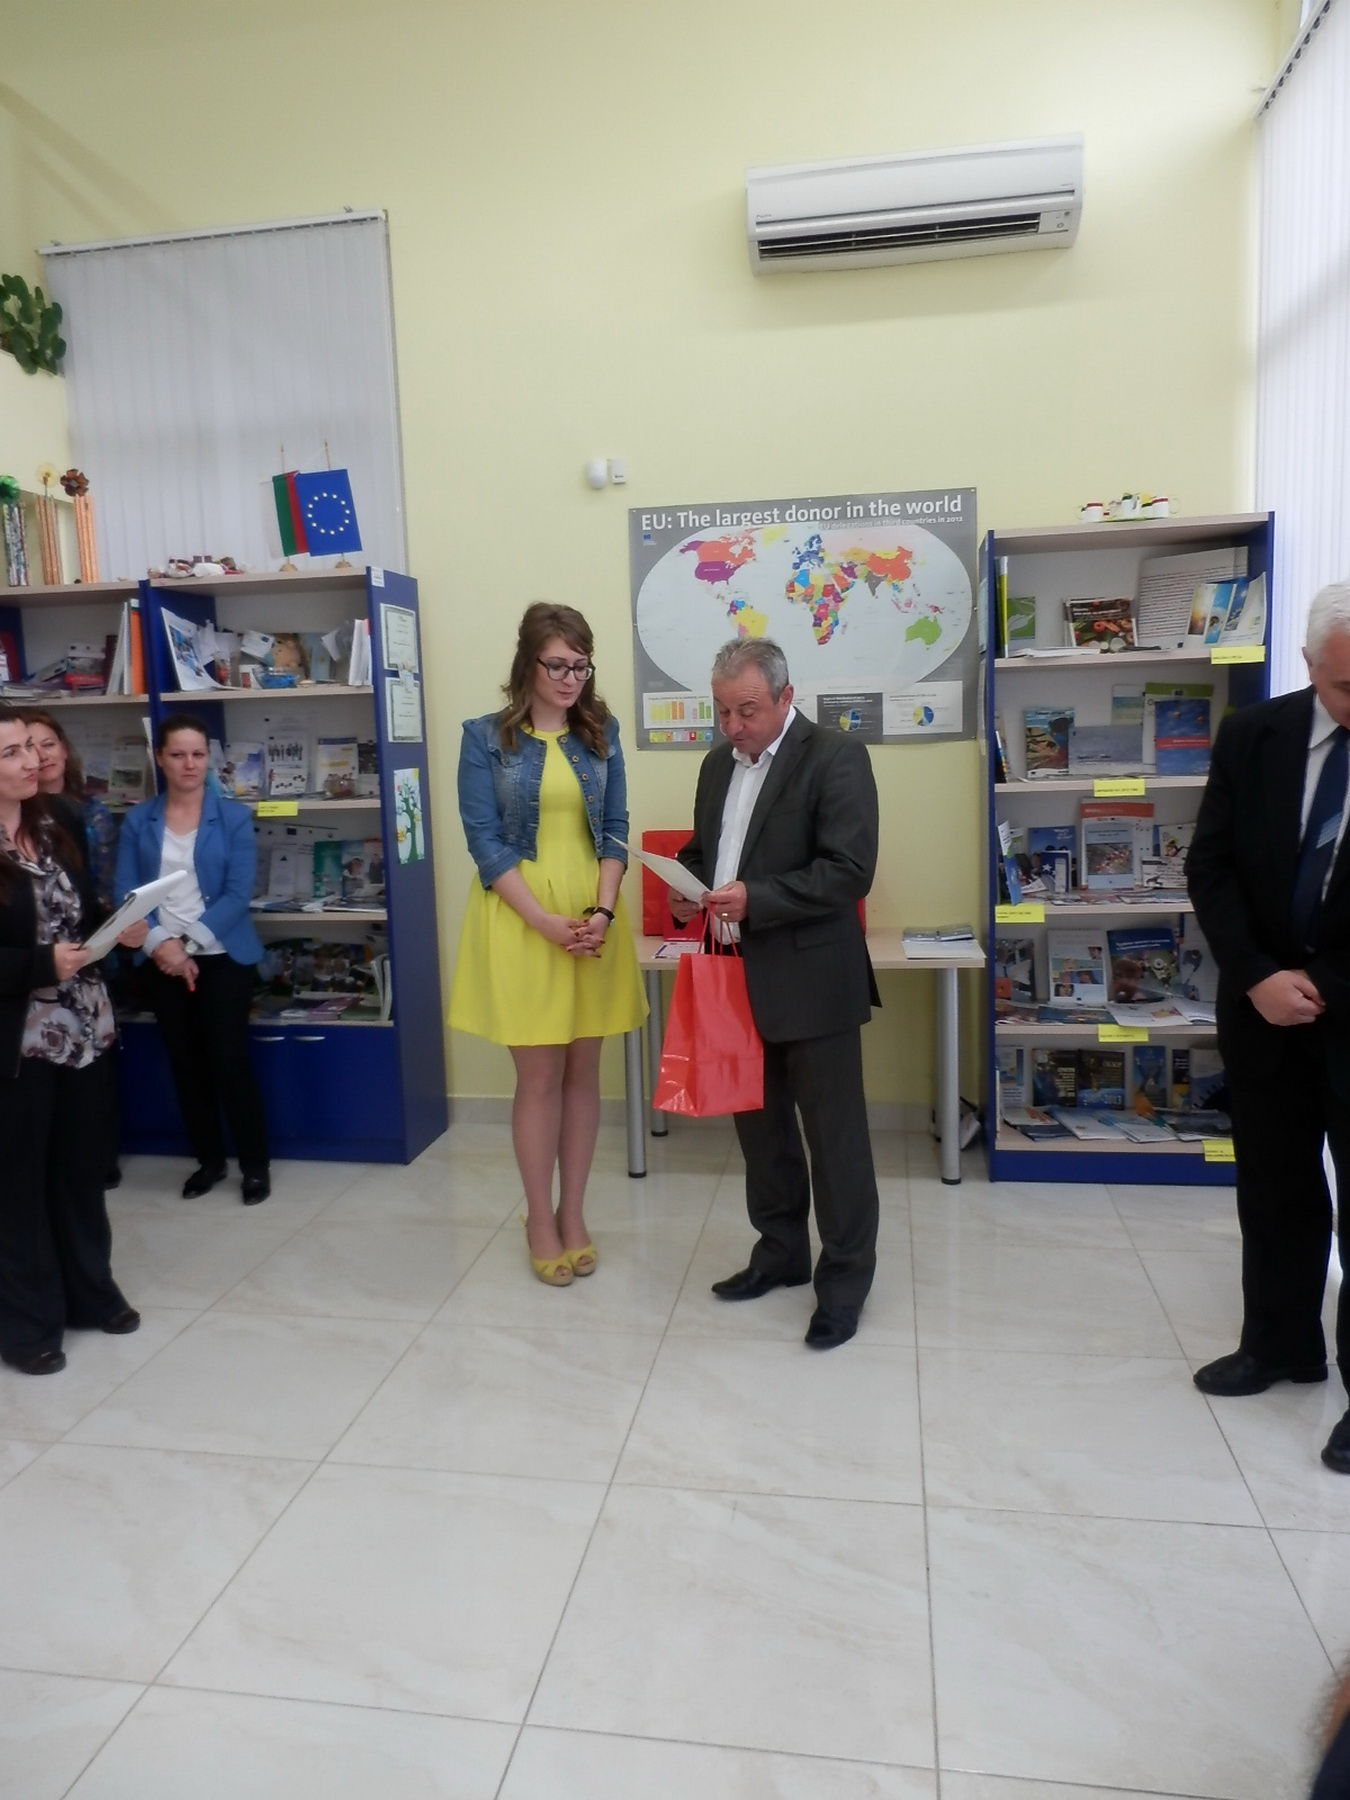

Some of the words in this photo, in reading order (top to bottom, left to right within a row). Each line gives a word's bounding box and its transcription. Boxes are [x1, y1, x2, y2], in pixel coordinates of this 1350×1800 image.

[641, 513, 672, 531] EU:
[677, 510, 711, 529] The
[716, 508, 781, 528] largest
[785, 504, 841, 523] donor
[846, 501, 864, 519] in
[869, 499, 901, 517] the
[906, 494, 962, 515] world
[882, 518, 901, 526] third
[902, 516, 936, 525] countries
[938, 515, 945, 523] in
[946, 515, 963, 523] 2012
